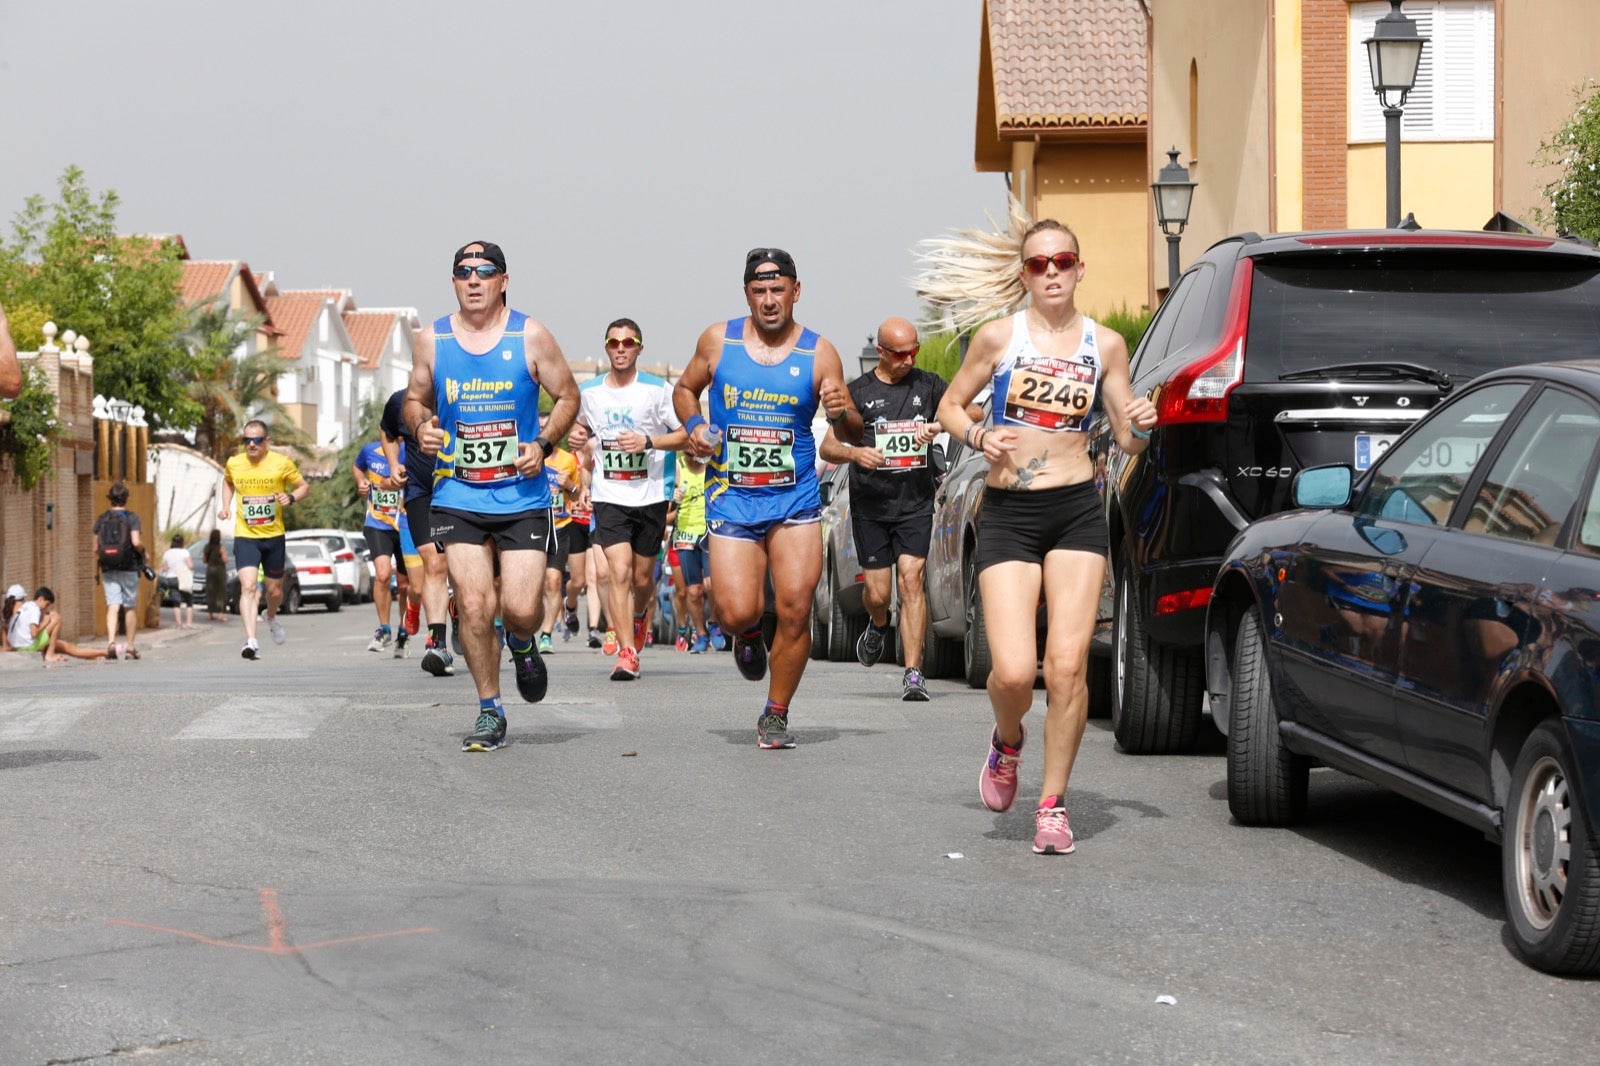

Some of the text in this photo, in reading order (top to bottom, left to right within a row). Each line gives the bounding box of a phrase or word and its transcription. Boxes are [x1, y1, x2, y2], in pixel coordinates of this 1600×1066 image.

[462, 378, 513, 393] olimpo
[742, 387, 799, 405] olimpo
[1019, 377, 1088, 410] 2246
[740, 400, 775, 410] deportes
[737, 413, 757, 421] TRAIL
[463, 440, 508, 464] 537
[739, 446, 783, 467] 525
[1360, 455, 1367, 463] E
[605, 452, 646, 468] 1117
[377, 492, 396, 504] 843
[248, 504, 271, 516] 846
